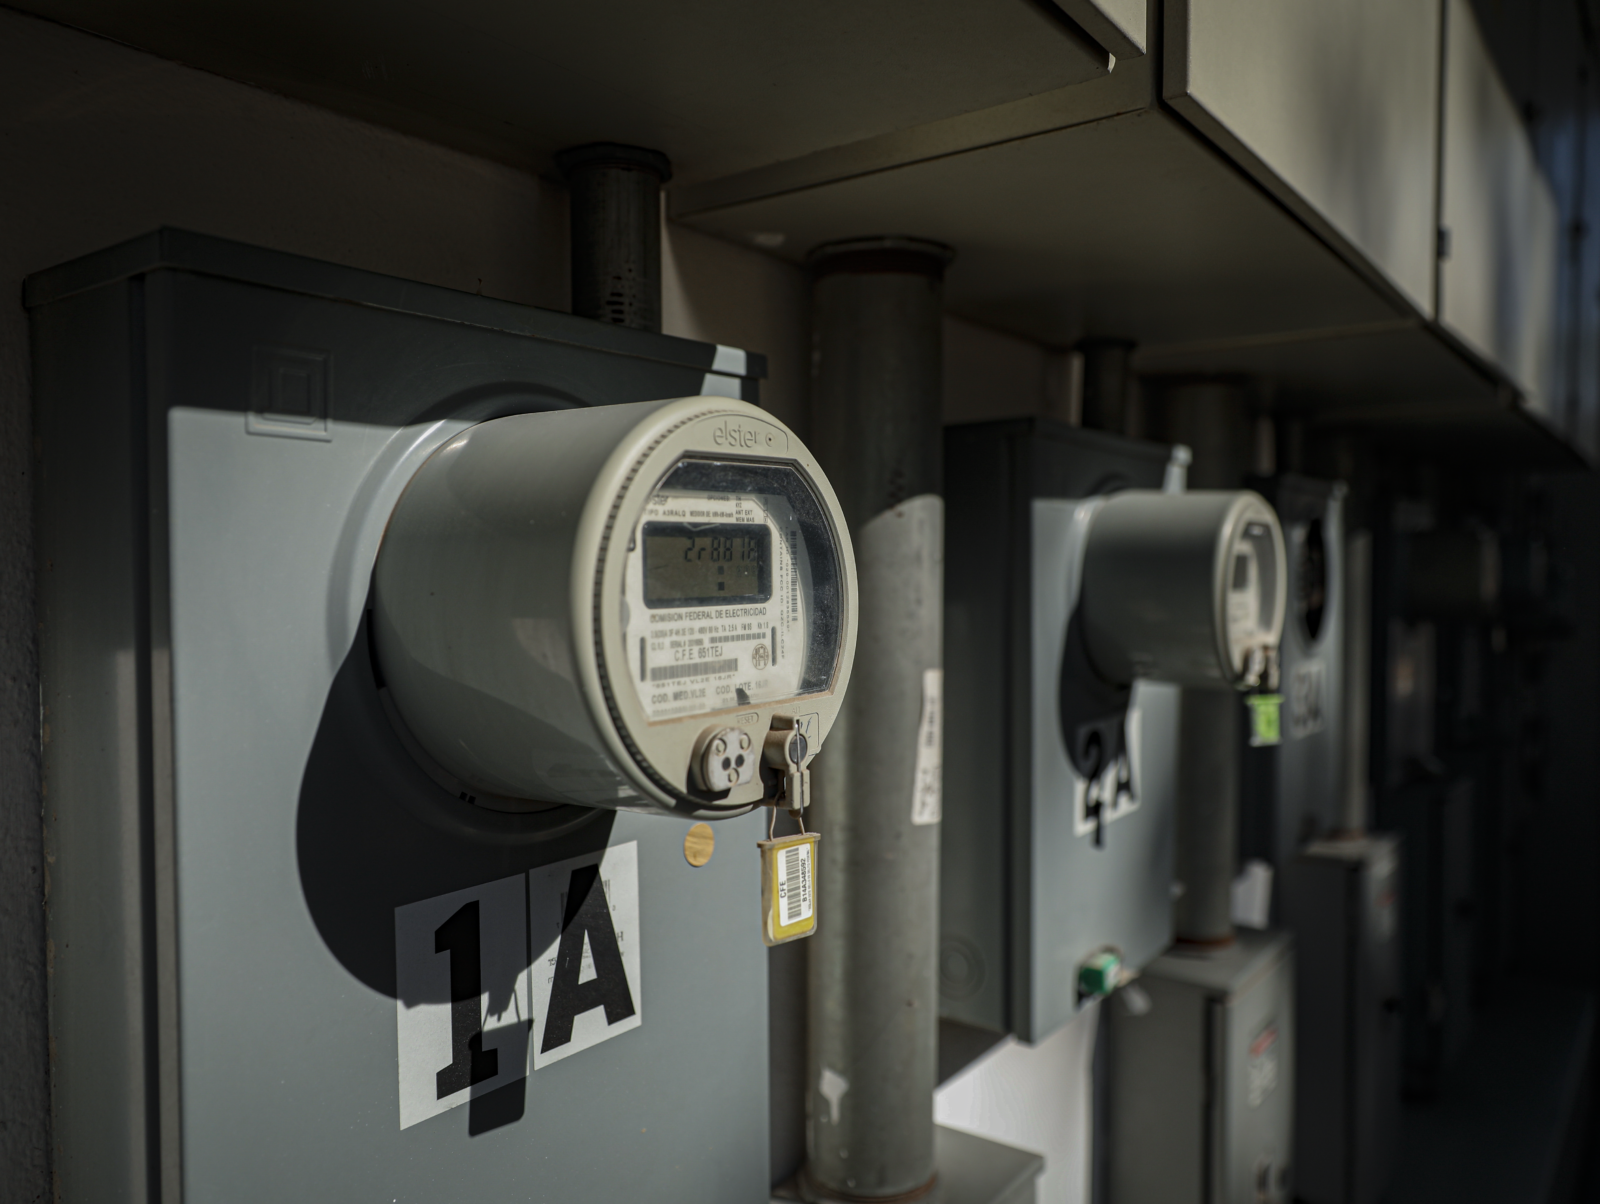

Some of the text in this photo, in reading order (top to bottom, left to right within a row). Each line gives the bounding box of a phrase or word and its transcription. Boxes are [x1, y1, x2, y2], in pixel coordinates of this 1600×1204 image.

[713, 420, 760, 449] elster
[684, 610, 714, 621] FEDERAL
[715, 609, 724, 619] DE
[725, 607, 767, 619] ELECTRICIDAD
[674, 649, 697, 662] C.F.E.
[715, 684, 733, 696] COD.
[651, 693, 670, 706] COD.
[779, 880, 787, 899] CFE
